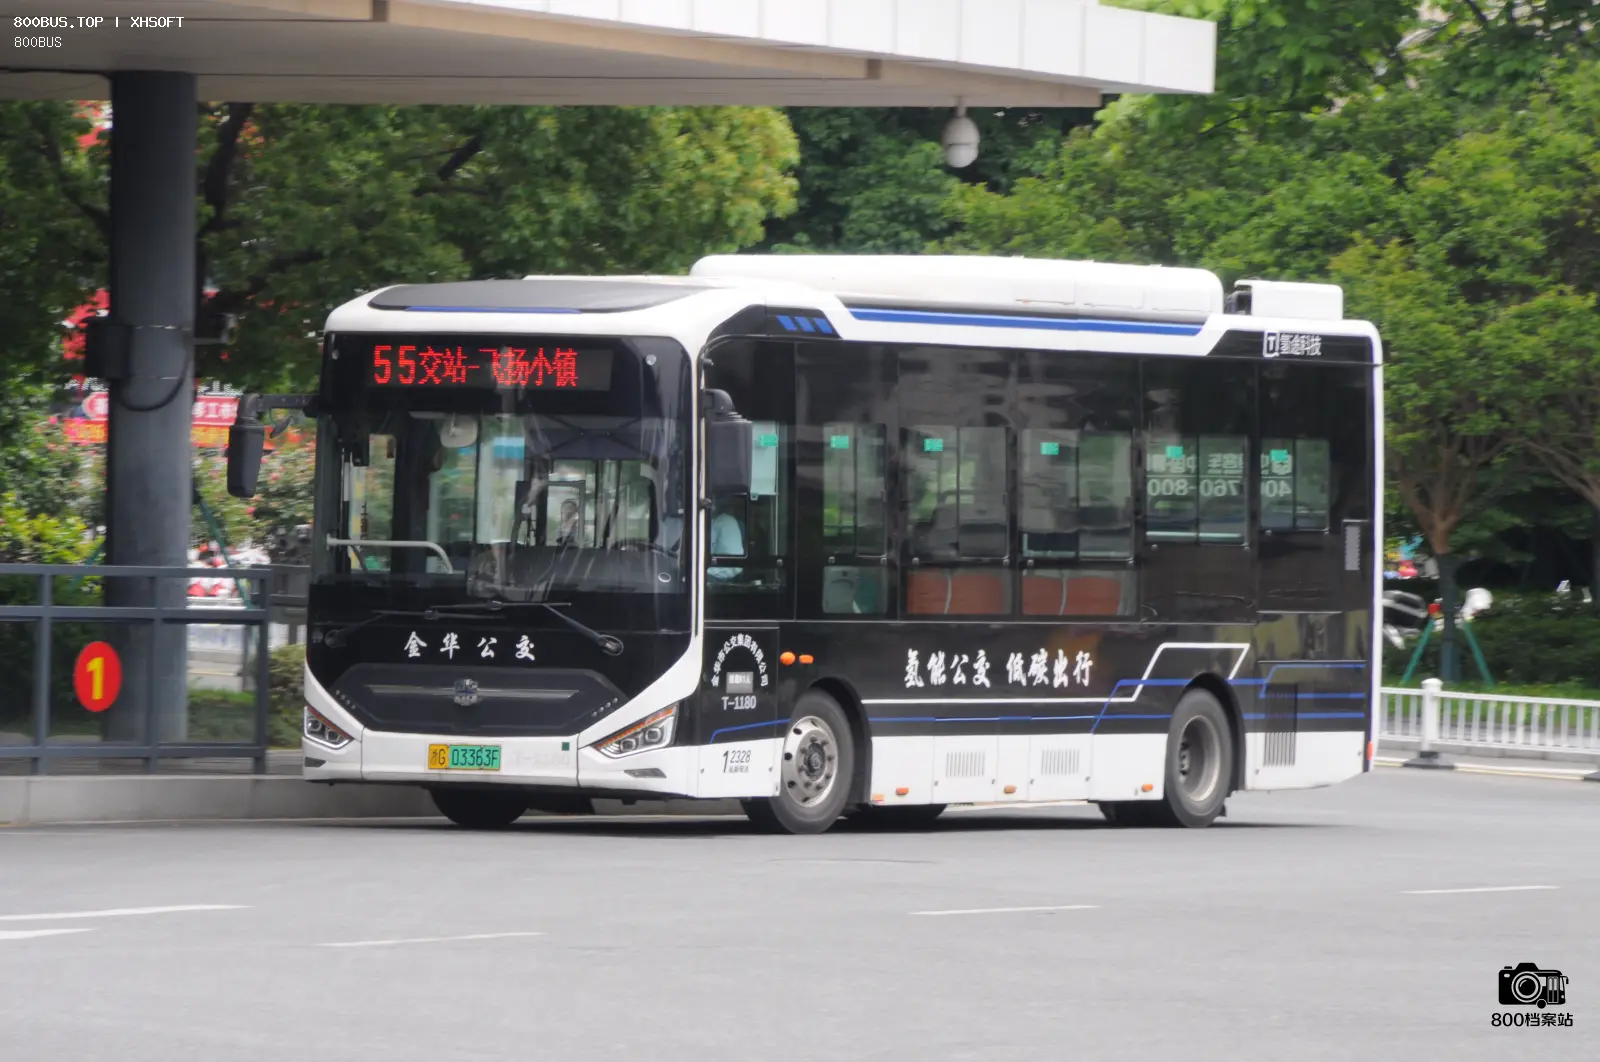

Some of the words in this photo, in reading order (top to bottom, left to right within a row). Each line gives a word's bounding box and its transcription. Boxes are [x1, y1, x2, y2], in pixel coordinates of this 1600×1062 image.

[404, 631, 535, 661] 金华公交
[86, 656, 104, 700] 1
[721, 695, 757, 710] T-1180
